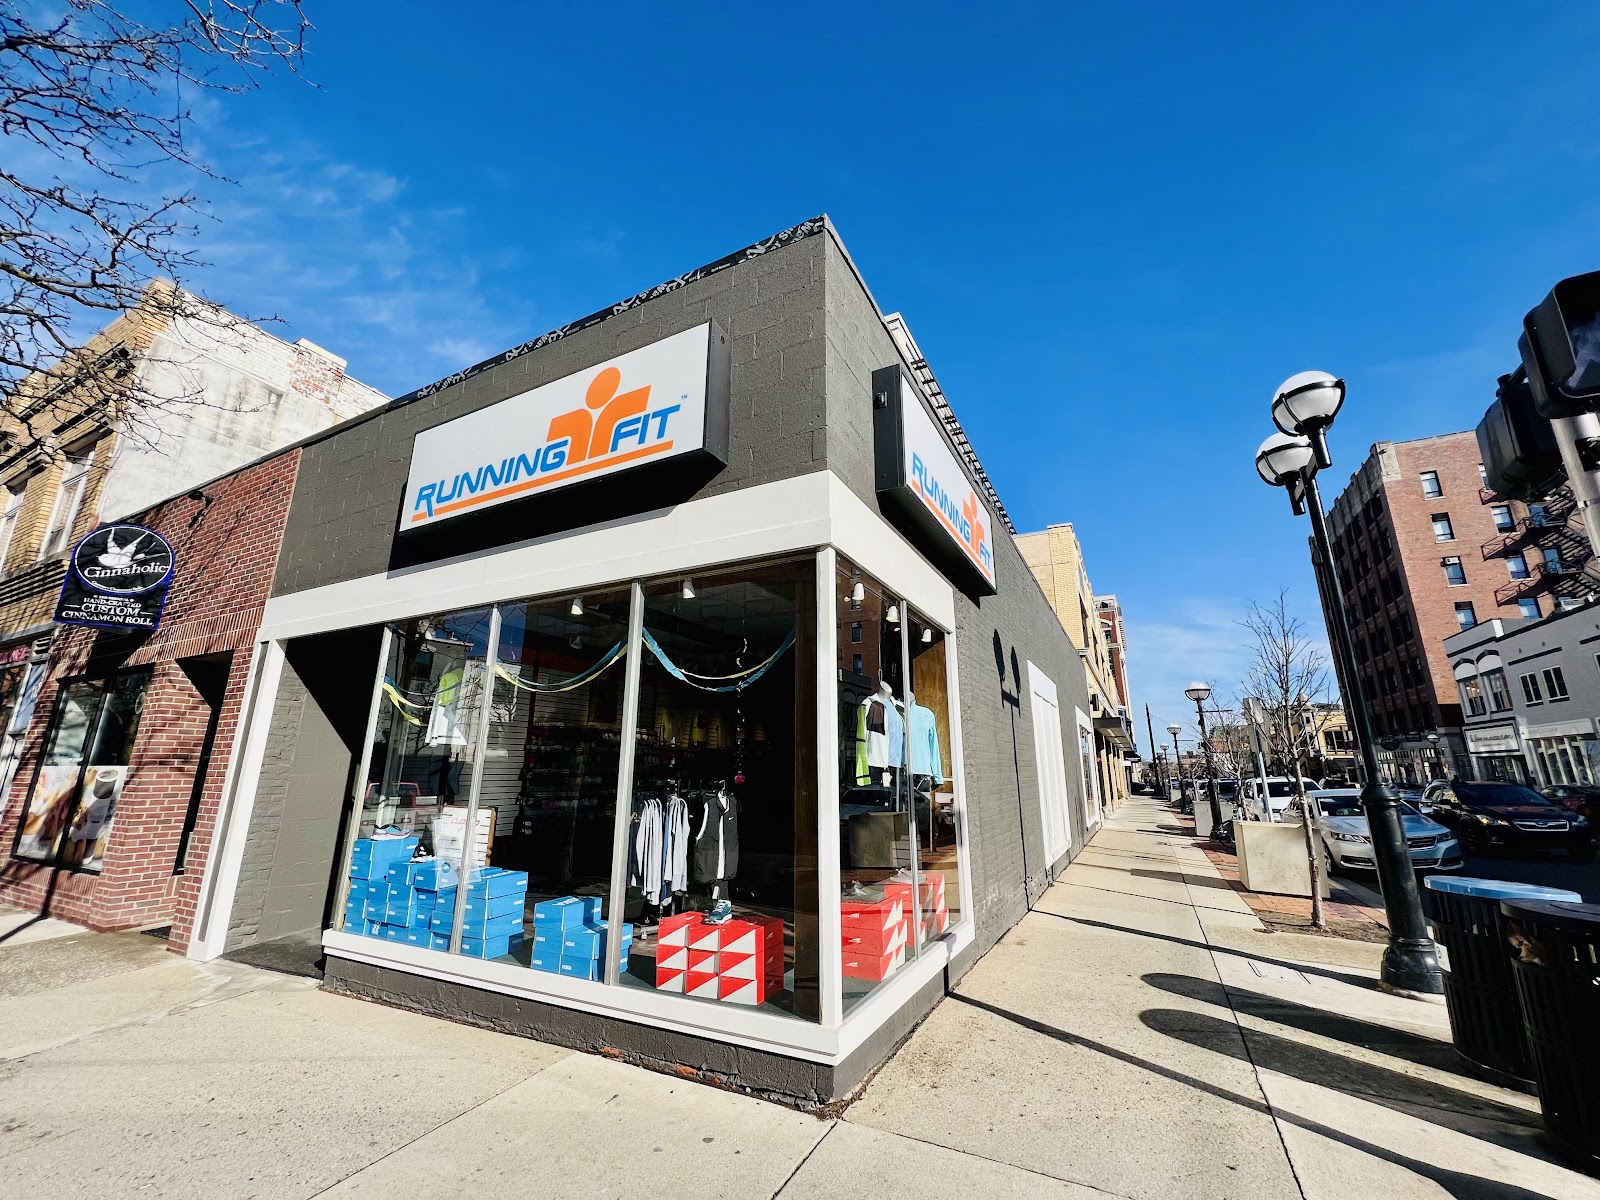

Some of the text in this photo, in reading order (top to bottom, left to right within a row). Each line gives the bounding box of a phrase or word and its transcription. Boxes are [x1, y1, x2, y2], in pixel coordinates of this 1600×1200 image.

[414, 439, 569, 517] RUNNING
[610, 404, 681, 452] FIT
[912, 451, 991, 570] RUNNING FIT
[84, 562, 169, 578] Cinnaholic
[62, 611, 124, 623] CINNAMON
[81, 603, 140, 616] CUSTOM
